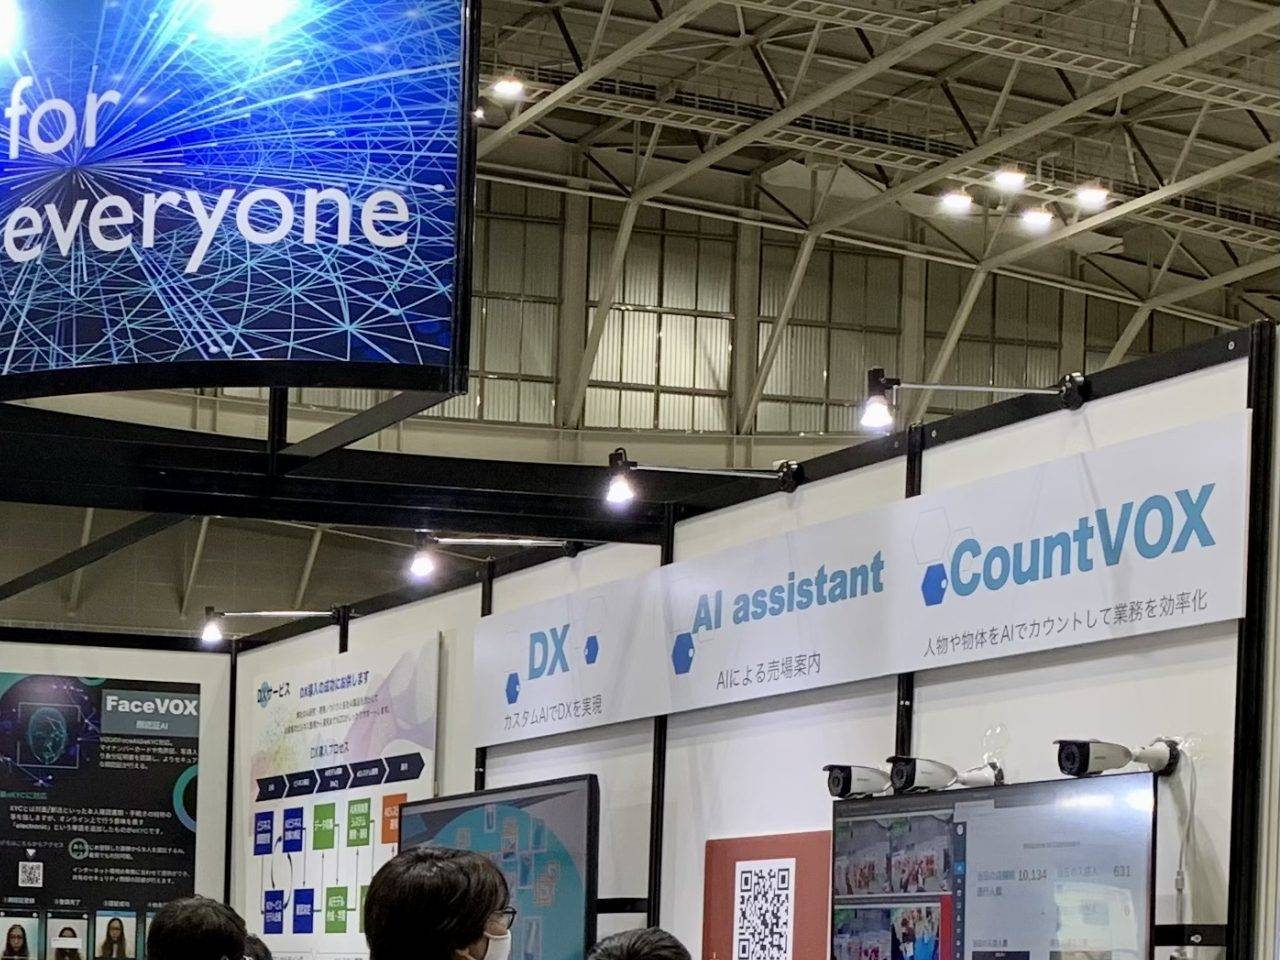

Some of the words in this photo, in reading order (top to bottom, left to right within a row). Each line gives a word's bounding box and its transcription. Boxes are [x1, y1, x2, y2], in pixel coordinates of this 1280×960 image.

[4, 75, 122, 159] for
[3, 186, 410, 273] everyone
[950, 482, 1217, 597] CountVOX
[691, 592, 723, 635] AI
[733, 549, 885, 626] assistant
[922, 588, 1208, 658] 人物や物体をAIでカウントして業務を効率化
[528, 623, 571, 681] DX
[716, 652, 822, 690] AIによる売場案内
[105, 695, 199, 716] FaceVOX
[503, 693, 603, 732] カスタムAIでDXを実現
